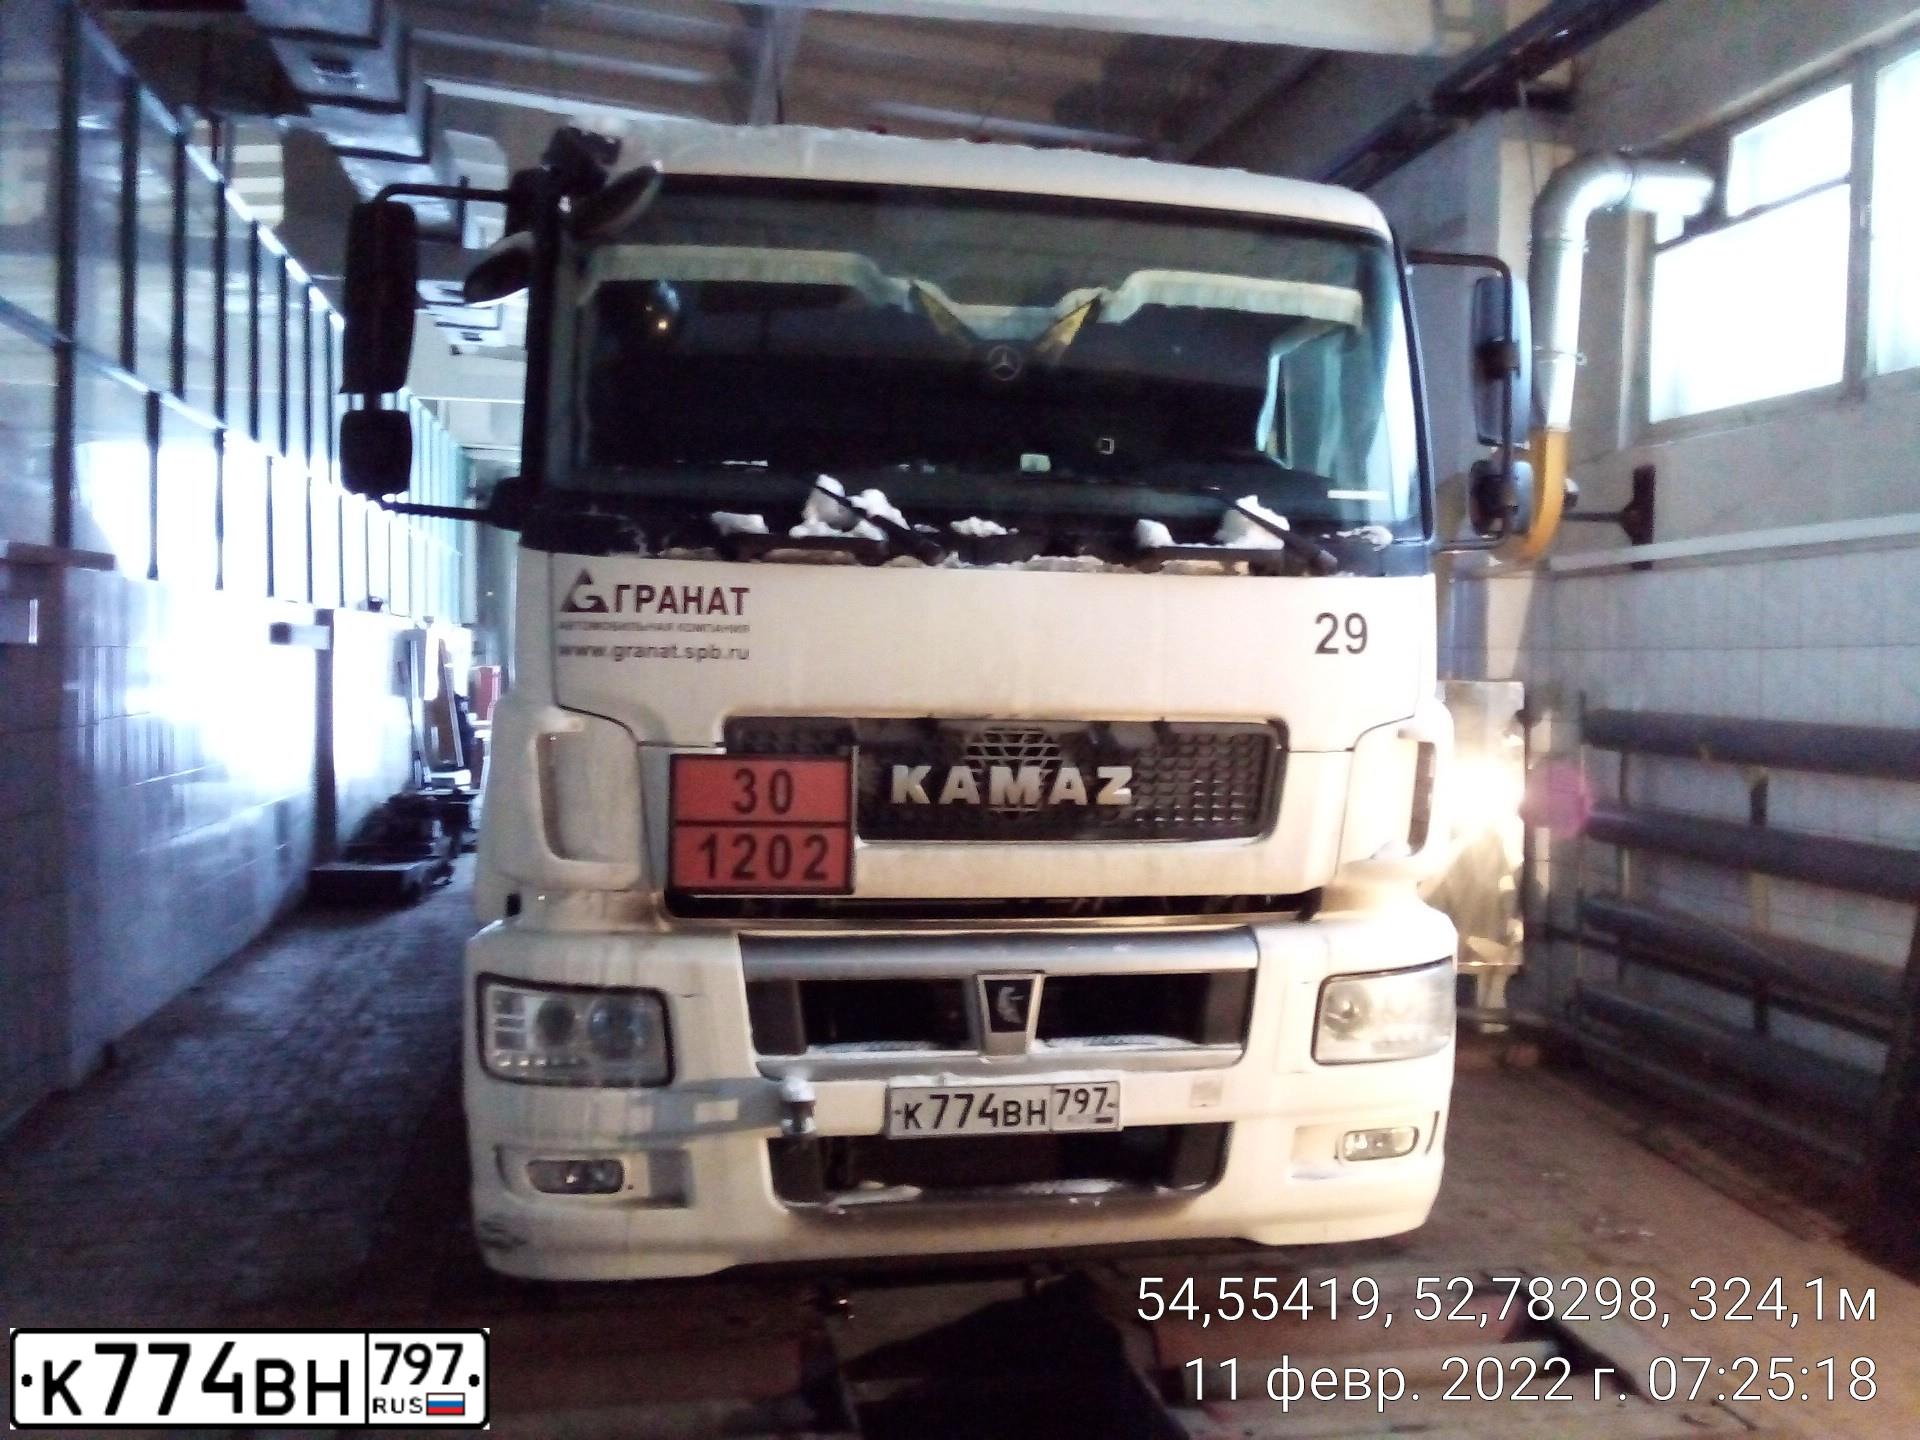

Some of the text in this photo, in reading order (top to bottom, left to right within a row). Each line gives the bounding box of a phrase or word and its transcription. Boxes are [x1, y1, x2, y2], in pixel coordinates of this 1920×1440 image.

[615, 584, 750, 615] ГРАНАТ
[559, 644, 749, 662] www.granat.spb.ru
[1315, 612, 1367, 654] 29
[732, 768, 794, 814] 30
[890, 765, 1132, 805] KAMAZ
[697, 834, 829, 880] 1202
[1056, 1087, 1108, 1115] 797
